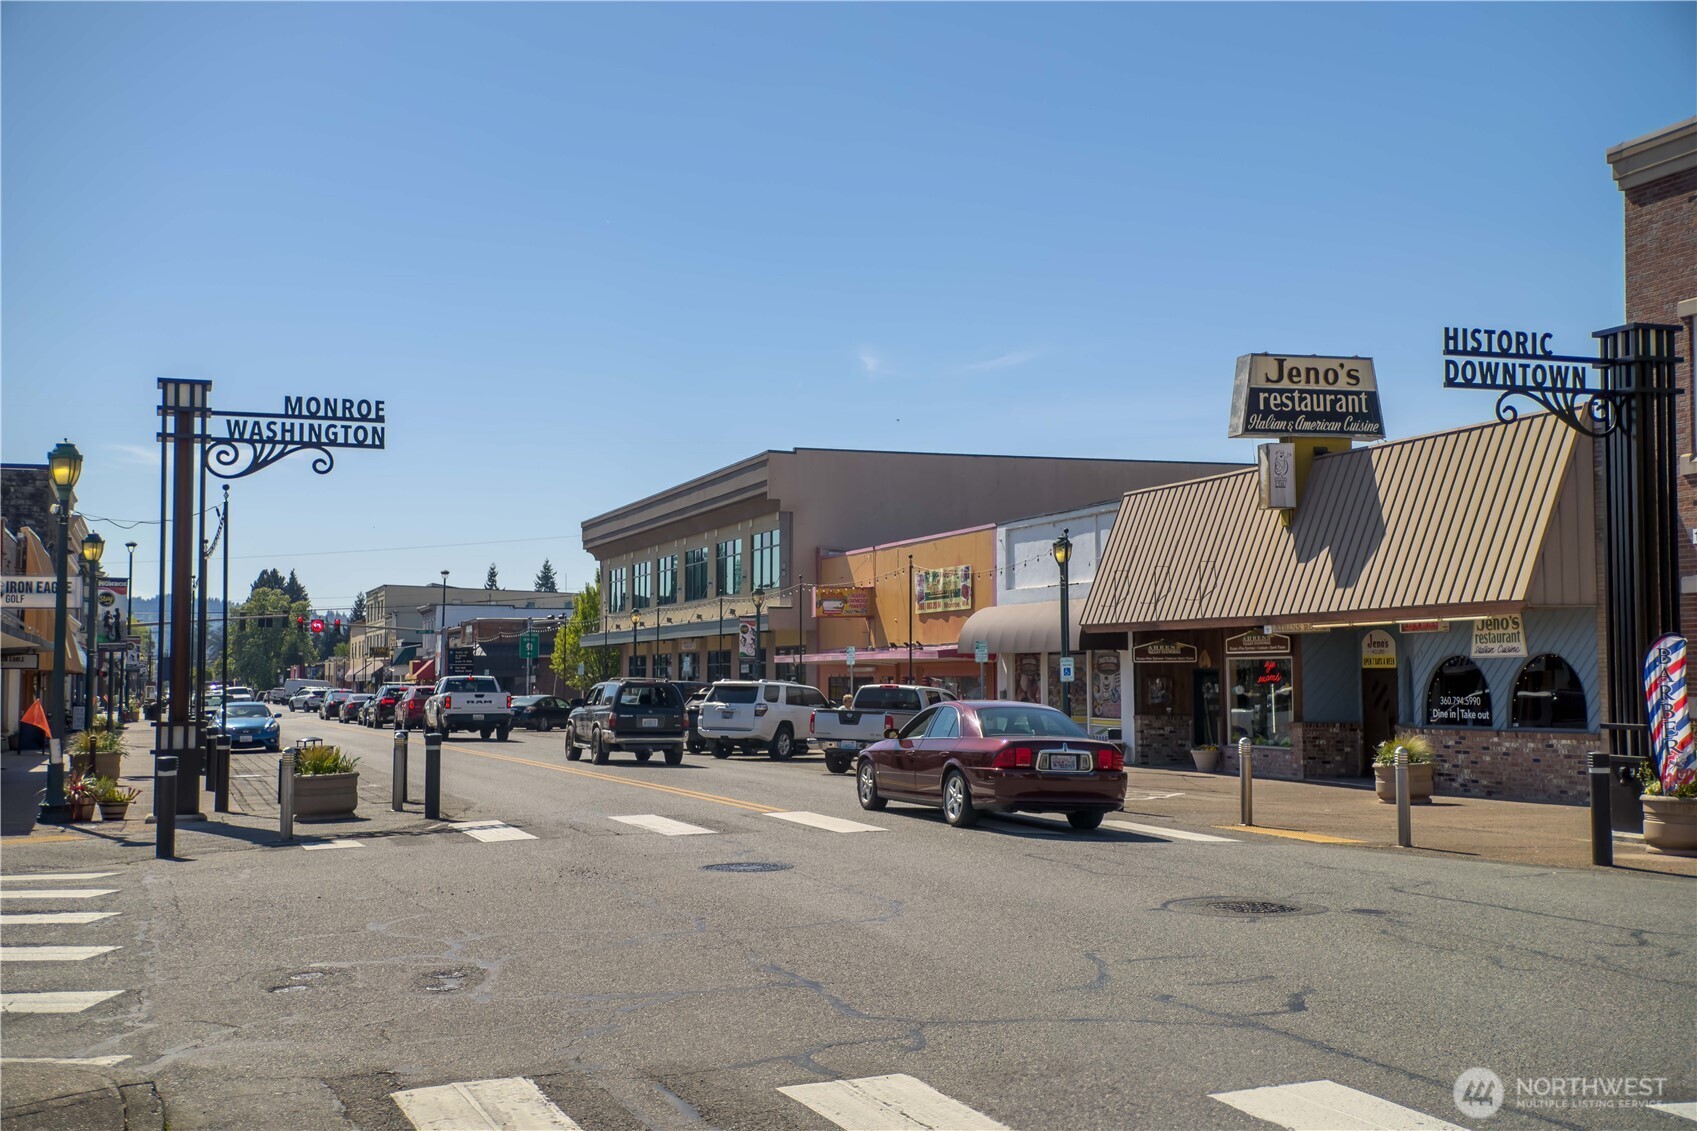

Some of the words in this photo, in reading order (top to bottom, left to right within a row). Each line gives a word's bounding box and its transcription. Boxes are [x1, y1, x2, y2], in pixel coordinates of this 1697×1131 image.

[1444, 326, 1553, 355] HISTORIC
[1265, 358, 1361, 386] Jeno's
[1444, 359, 1586, 389] DOWNTOWN
[284, 396, 385, 420] MONROE
[1259, 389, 1369, 413] restaurant
[226, 419, 385, 446] WASHINGTON
[1248, 414, 1287, 431] Italian
[1288, 421, 1294, 432] &
[1295, 414, 1341, 431] American
[1343, 416, 1380, 433] Cuisine
[5, 581, 33, 594] IRON
[36, 581, 72, 594] EAGE
[5, 594, 25, 603] GOLF
[1476, 615, 1520, 631] Jeno's
[1367, 634, 1389, 648] Jeno's
[1474, 630, 1521, 644] restaurant
[1657, 647, 1683, 755] BARBER
[1432, 708, 1449, 718] Dine
[1449, 708, 1457, 718] in
[1459, 709, 1476, 719] Take
[1477, 710, 1490, 720] out
